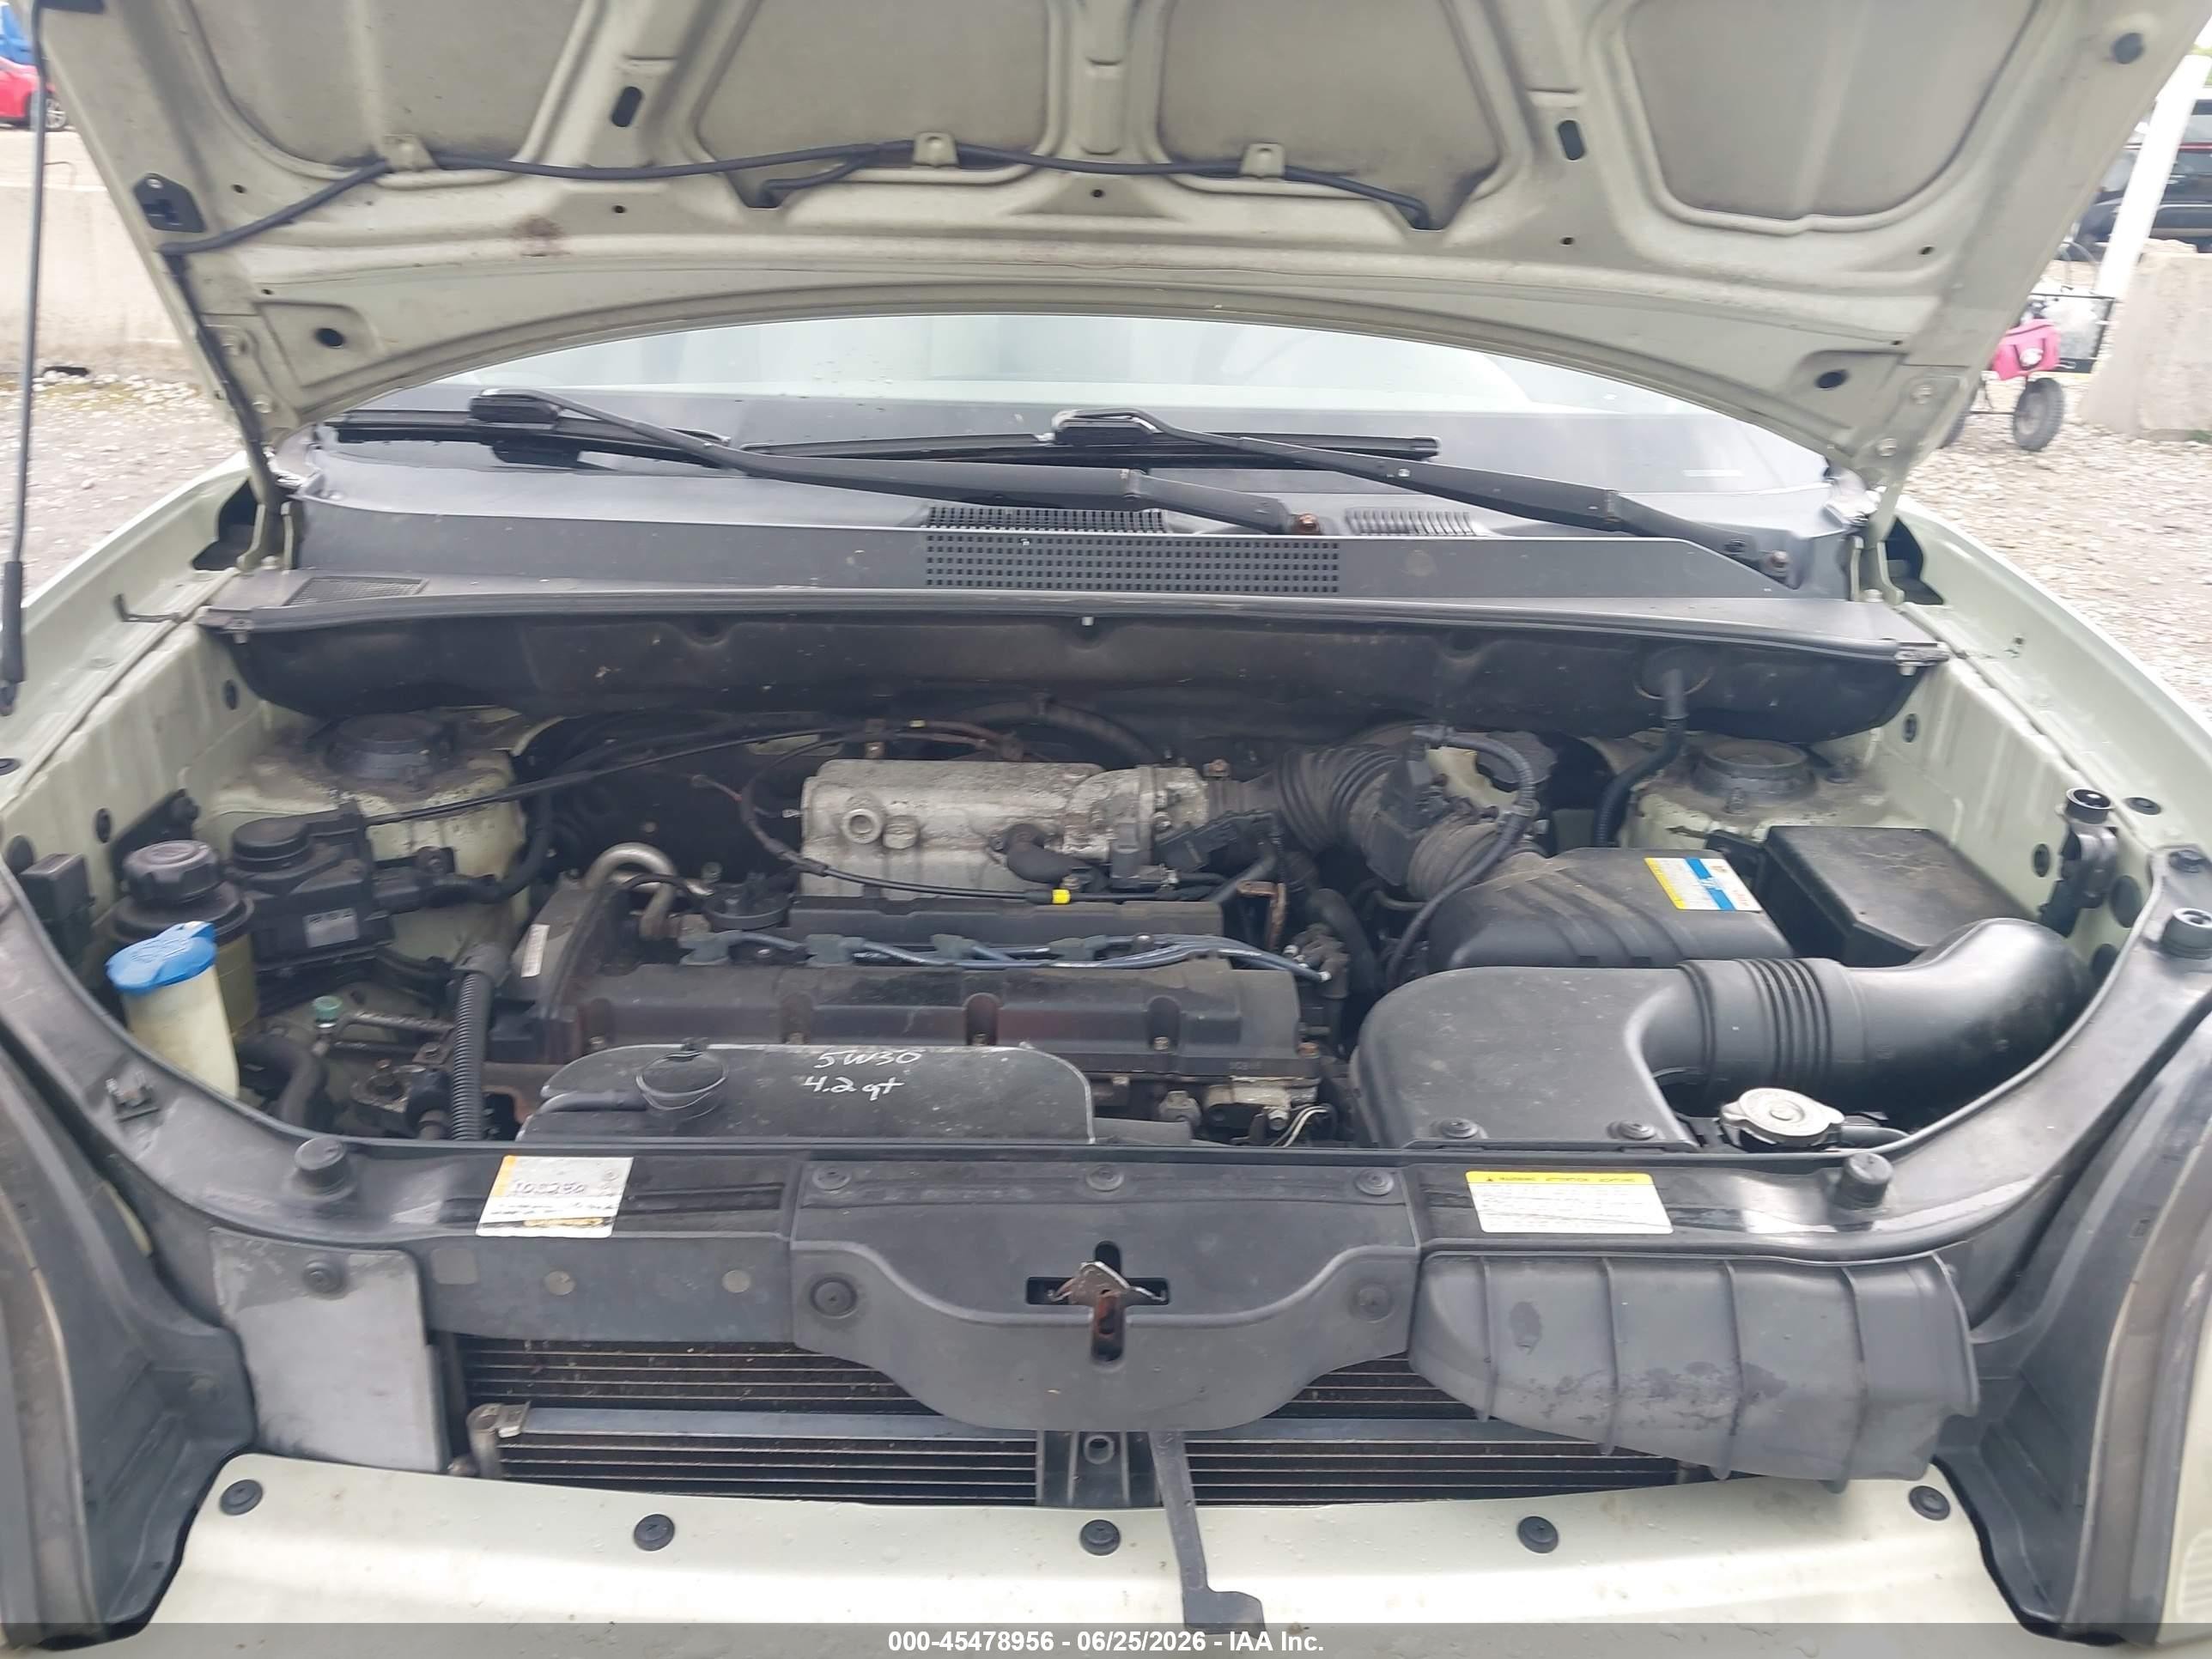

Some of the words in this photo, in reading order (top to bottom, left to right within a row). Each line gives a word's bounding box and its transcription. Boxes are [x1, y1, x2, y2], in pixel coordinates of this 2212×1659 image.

[813, 1049, 927, 1068] 5W30
[803, 1075, 857, 1093] 4.2
[861, 1077, 905, 1102] qt
